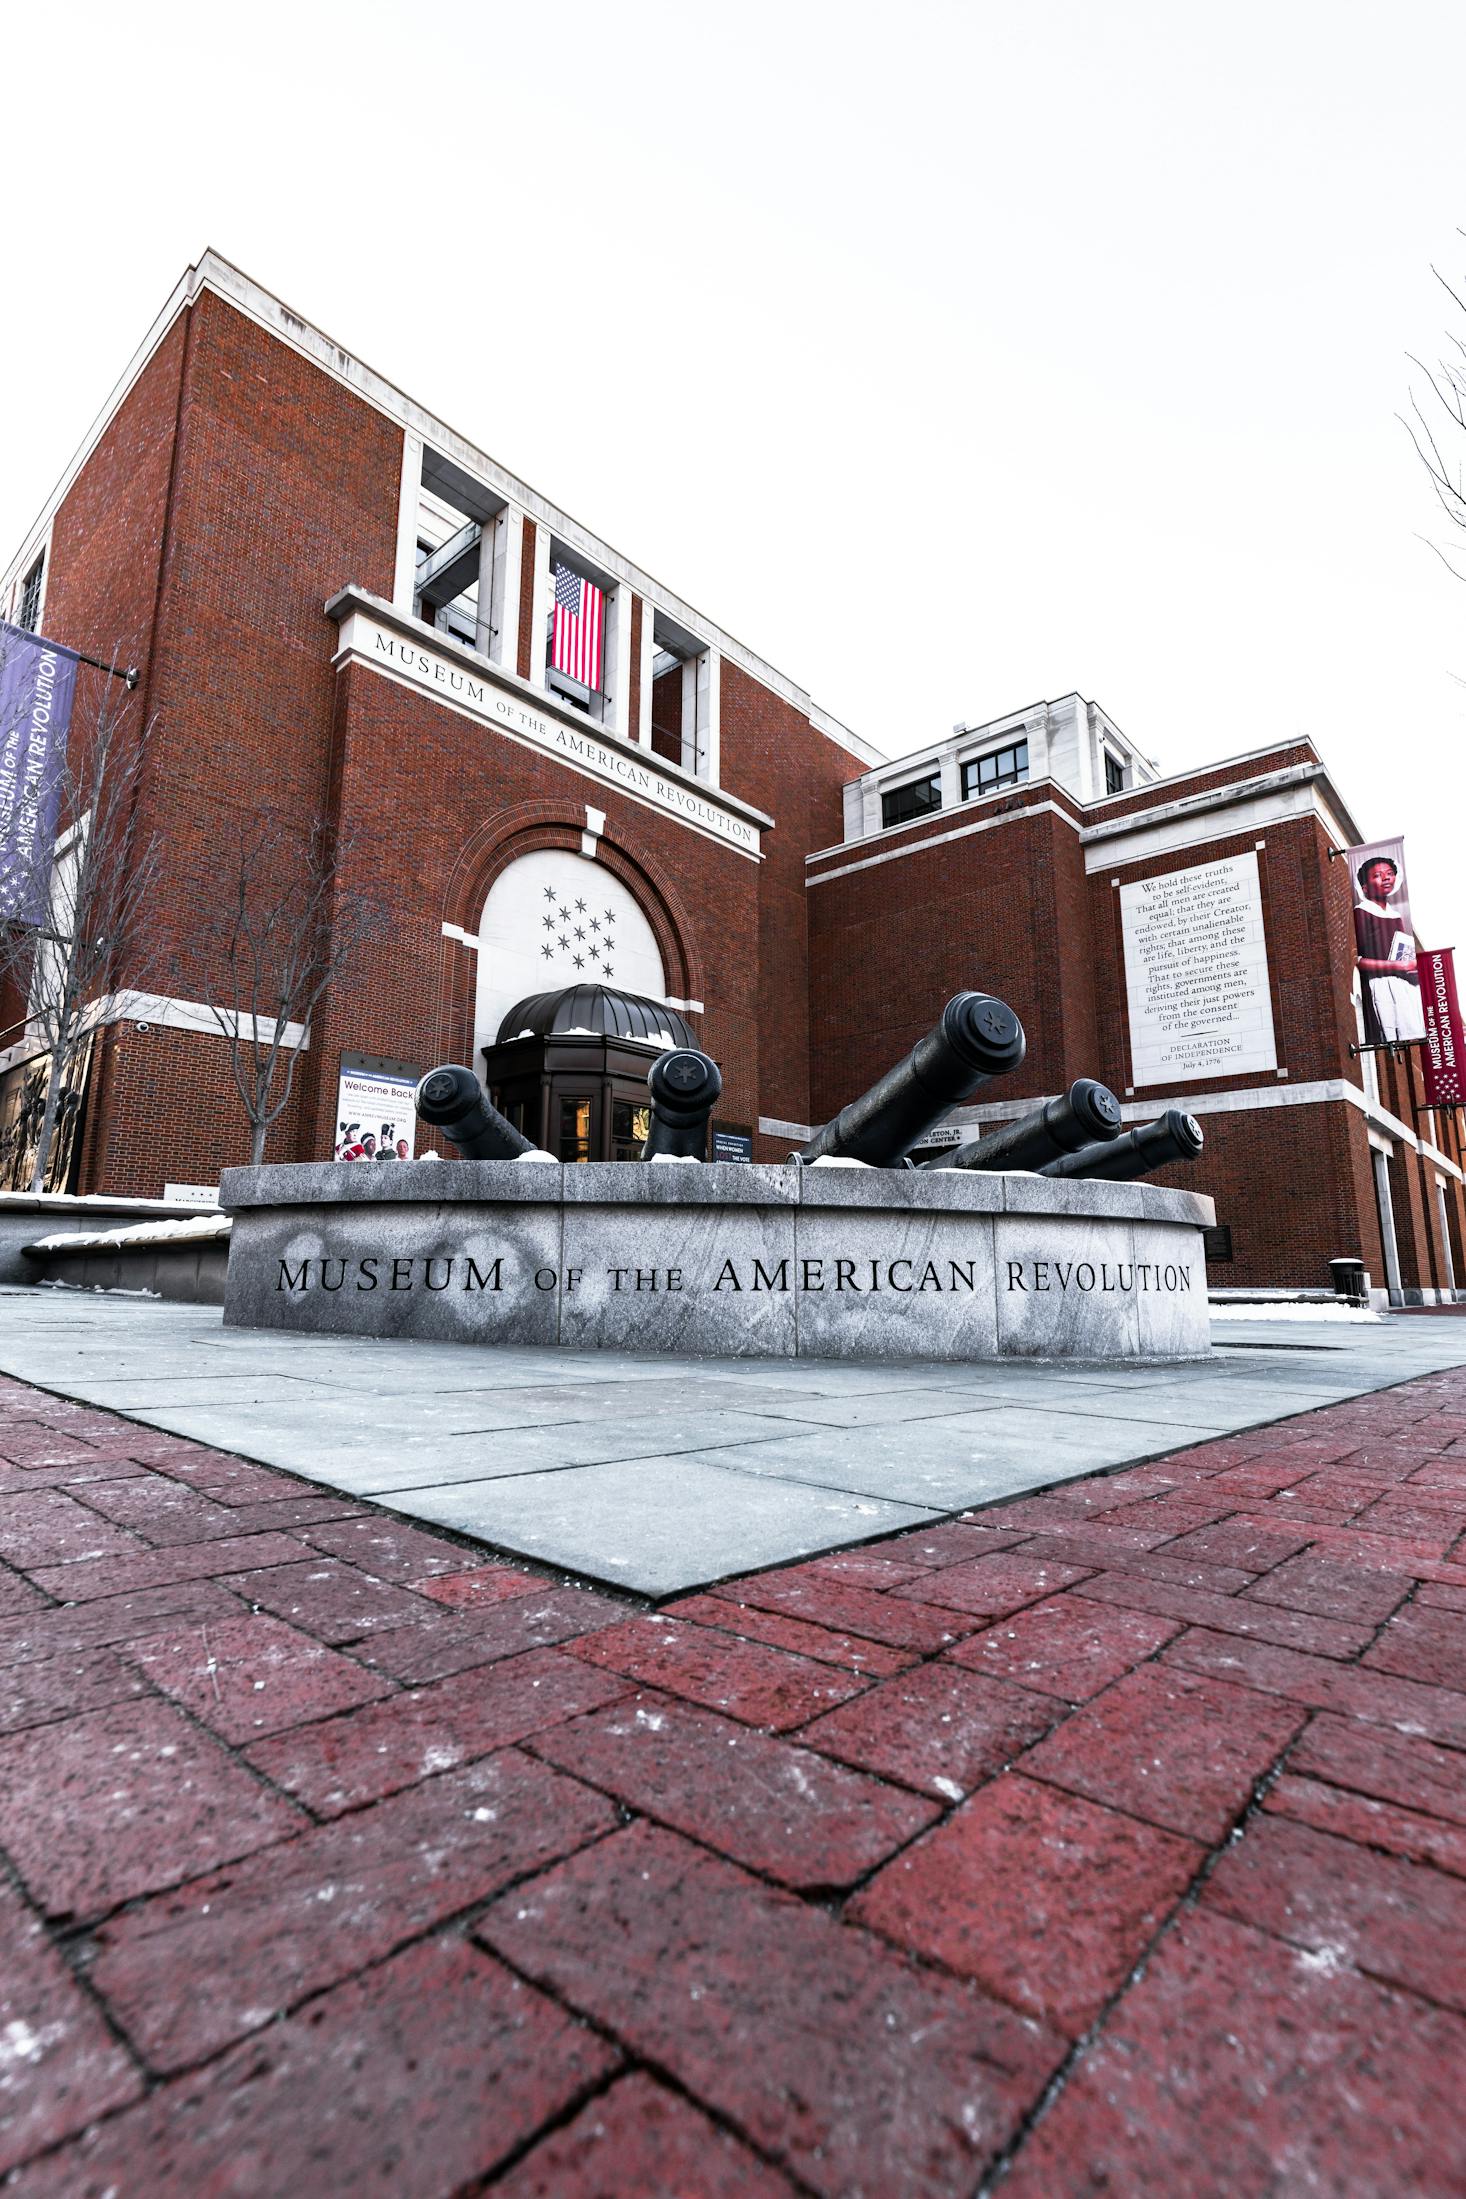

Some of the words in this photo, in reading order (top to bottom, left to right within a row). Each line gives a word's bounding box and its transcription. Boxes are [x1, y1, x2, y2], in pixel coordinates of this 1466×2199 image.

[29, 648, 58, 758] REVOLUTION
[8, 730, 20, 752] THE
[376, 633, 484, 702] MUSEUM
[496, 702, 514, 716] OF
[520, 712, 546, 735] THE
[556, 730, 649, 788] AMERICAN
[657, 781, 752, 840] REVOLUTION
[4, 753, 16, 770] OF
[16, 759, 44, 860] AMERICAN
[1142, 882, 1156, 893] We
[1159, 878, 1178, 890] hold
[1180, 873, 1202, 884] these
[1205, 866, 1233, 877] truths
[1164, 890, 1173, 898] be
[1176, 878, 1227, 895] self-evident,
[1136, 905, 1156, 914] That
[1158, 900, 1168, 909] all
[1171, 897, 1190, 906] men
[1192, 892, 1206, 901] are
[1208, 883, 1240, 897] created
[1177, 905, 1194, 914] that
[1197, 901, 1214, 910] they
[1218, 896, 1231, 904] are
[1135, 920, 1176, 935] endowed,
[1178, 917, 1187, 926] by
[1190, 912, 1211, 922] their
[1214, 903, 1251, 917] Creator,
[1138, 934, 1157, 944] with
[1160, 928, 1190, 939] certain
[1192, 915, 1244, 932] unalienable
[1140, 944, 1166, 955] rights;
[1168, 940, 1185, 948] that
[1189, 932, 1220, 943] among
[1222, 926, 1246, 936] these
[1143, 955, 1156, 963] are
[1157, 951, 1175, 960] life,
[1177, 944, 1209, 955] liberty,
[1210, 938, 1227, 949] and
[1230, 935, 1245, 944] the
[1148, 961, 1179, 975] pursuit
[1182, 956, 1192, 966] of
[1148, 974, 1170, 983] That
[1184, 965, 1213, 976] secure
[1216, 959, 1240, 970] these
[1146, 983, 1172, 994] rights,
[1175, 971, 1231, 990] governments
[1233, 968, 1248, 976] are
[1148, 988, 1189, 1002] instituted
[1191, 983, 1221, 994] among
[1224, 979, 1247, 989] men,
[1432, 954, 1448, 1013] REVOLUTION
[1144, 1001, 1178, 1014] deriving
[1180, 998, 1201, 1009] their
[1202, 995, 1220, 1006] just
[1223, 989, 1255, 1002] powers
[1159, 1012, 1181, 1021] from
[1183, 1009, 1197, 1017] the
[1200, 1003, 1238, 1014] consent
[1162, 1022, 1172, 1031] of
[1174, 1020, 1188, 1029] the
[1429, 1017, 1436, 1026] OF
[1170, 1038, 1230, 1053] DECLARATION
[1175, 1045, 1242, 1060] INDEPENDENCE
[1430, 1027, 1442, 1069] MUSEUM
[1441, 1016, 1456, 1068] AMERICAN
[1206, 1058, 1221, 1066] 1776
[344, 1080, 388, 1095] Welcome
[391, 1088, 414, 1099] Back
[926, 1130, 952, 1138] LETON,
[930, 1135, 956, 1143] CENTER
[274, 1258, 504, 1292] MUSEUM
[534, 1268, 582, 1292] OF
[608, 1268, 684, 1292] THE
[713, 1258, 976, 1292] AMERICAN
[1006, 1262, 1190, 1292] REVOLUTION
